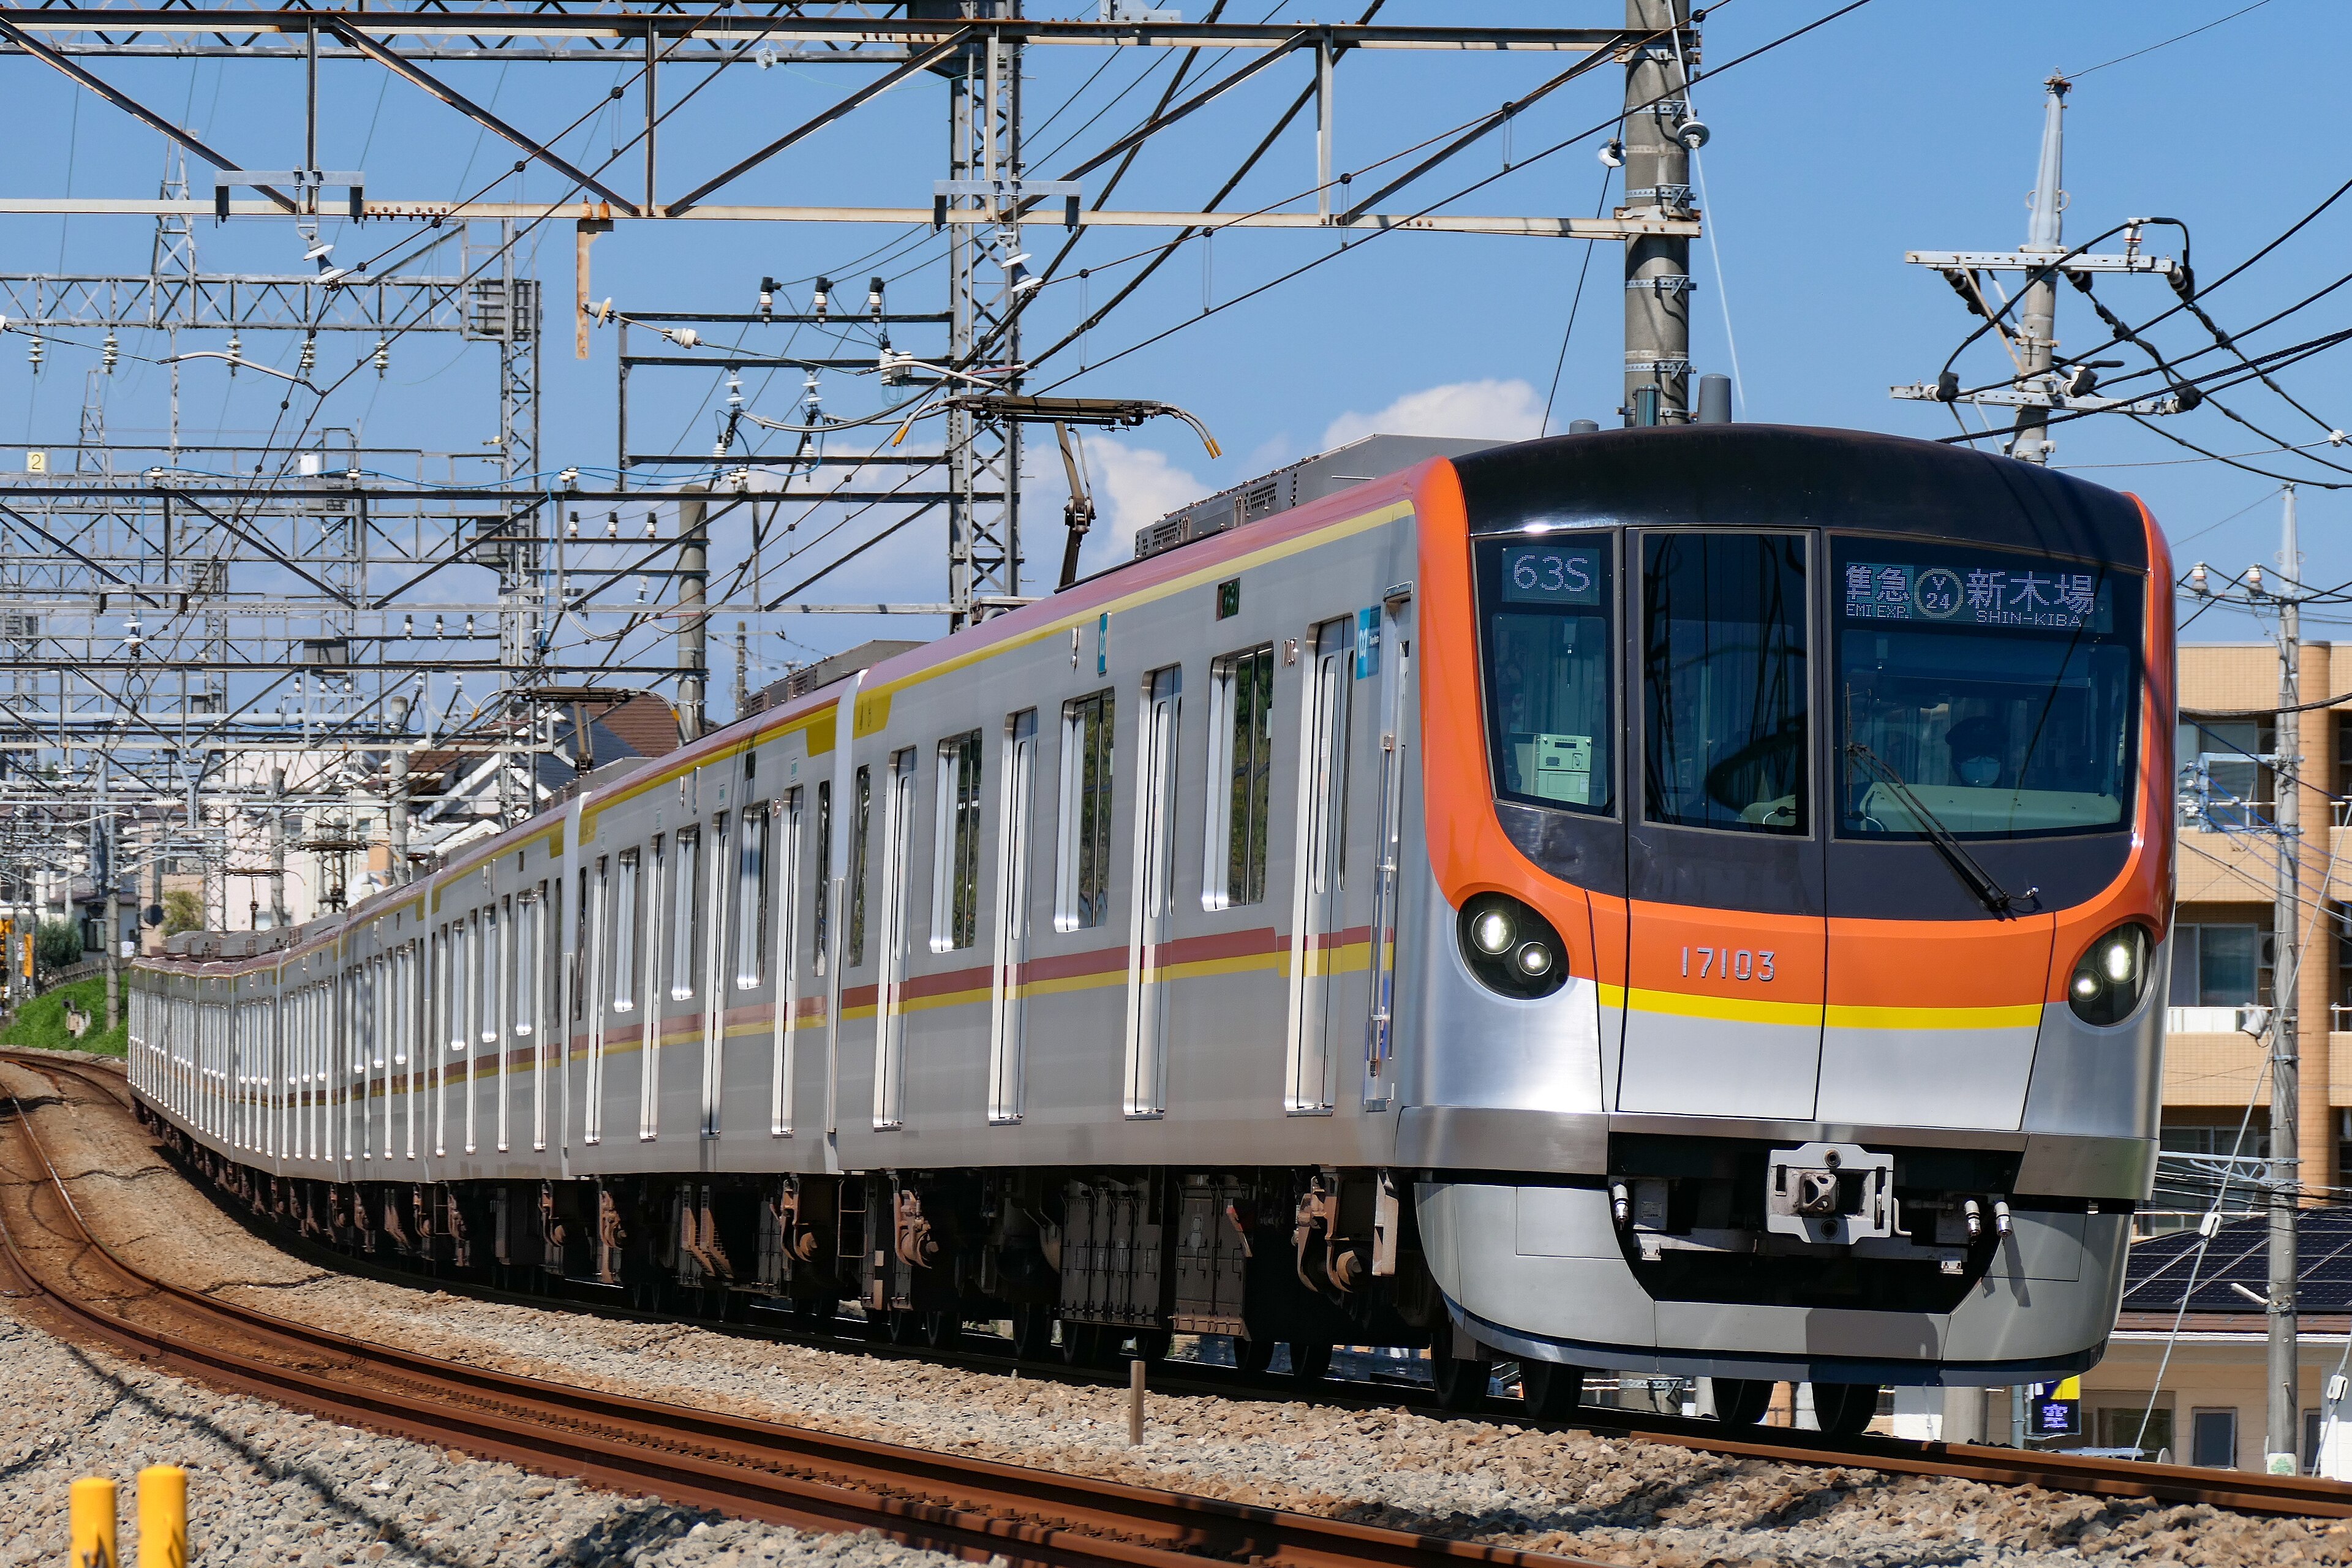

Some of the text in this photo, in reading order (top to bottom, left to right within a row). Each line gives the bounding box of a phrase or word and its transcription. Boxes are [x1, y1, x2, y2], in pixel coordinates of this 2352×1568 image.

[31, 454, 42, 470] 2
[1513, 554, 1591, 592] 63S
[1932, 576, 1947, 590] Y
[1926, 592, 1950, 609] 24
[1966, 568, 2095, 614] 新木場
[1976, 609, 2082, 627] SHIN-KIBA
[1682, 946, 1776, 981] 17103
[2041, 1403, 2068, 1428] 空
